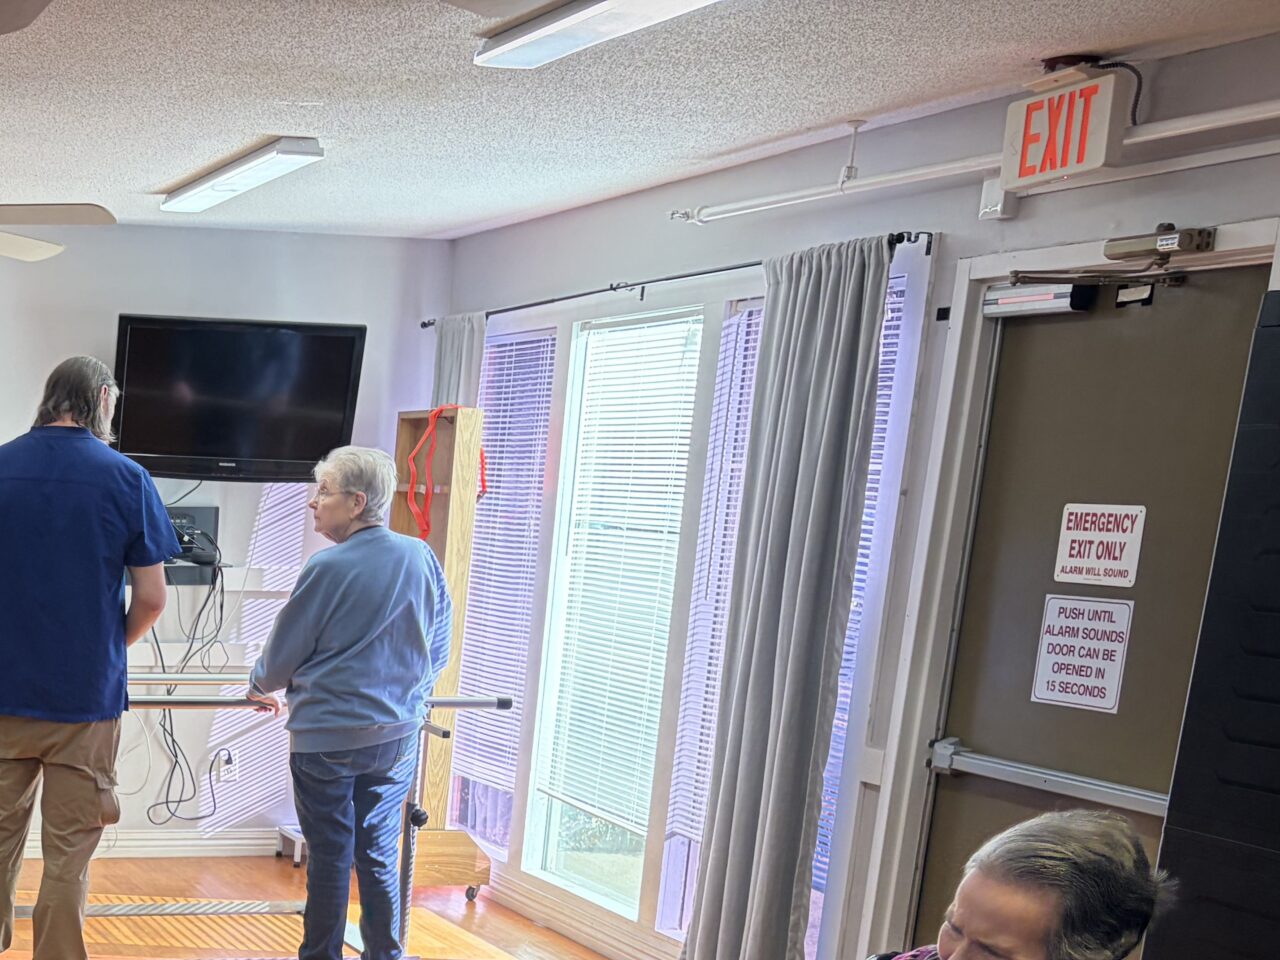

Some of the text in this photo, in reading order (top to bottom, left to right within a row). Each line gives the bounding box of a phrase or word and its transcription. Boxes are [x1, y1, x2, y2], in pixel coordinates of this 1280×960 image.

[1018, 84, 1099, 178] EXIT
[1066, 512, 1138, 534] EMERGENCY
[1068, 539, 1126, 561] EXIT ONLY
[1060, 565, 1129, 578] ALARM WILL SOUND
[1058, 607, 1116, 623] PUSH UNTIL
[1045, 624, 1124, 643] ALARM SOUNDS
[1047, 643, 1117, 662] DOOR CAN BE
[1052, 662, 1105, 679] OPENED IN
[1046, 680, 1106, 699] 15 SECONDS
